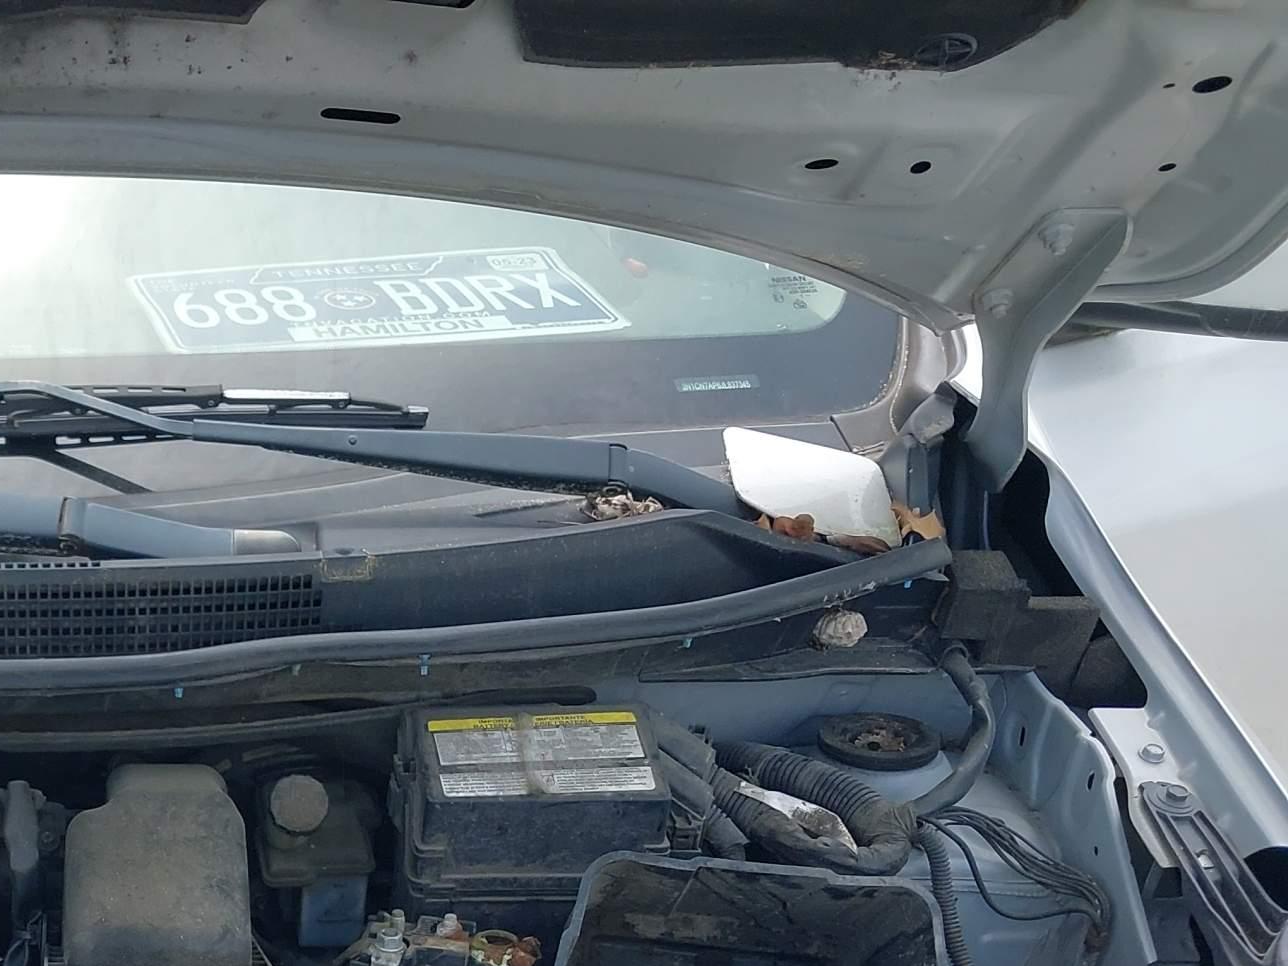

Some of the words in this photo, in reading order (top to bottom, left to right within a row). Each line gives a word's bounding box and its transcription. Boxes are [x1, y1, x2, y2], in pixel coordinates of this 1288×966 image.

[272, 261, 420, 279] TENNESSEE
[173, 286, 317, 328] 688
[373, 272, 582, 316] BDRX
[313, 318, 485, 339] HAMILTON
